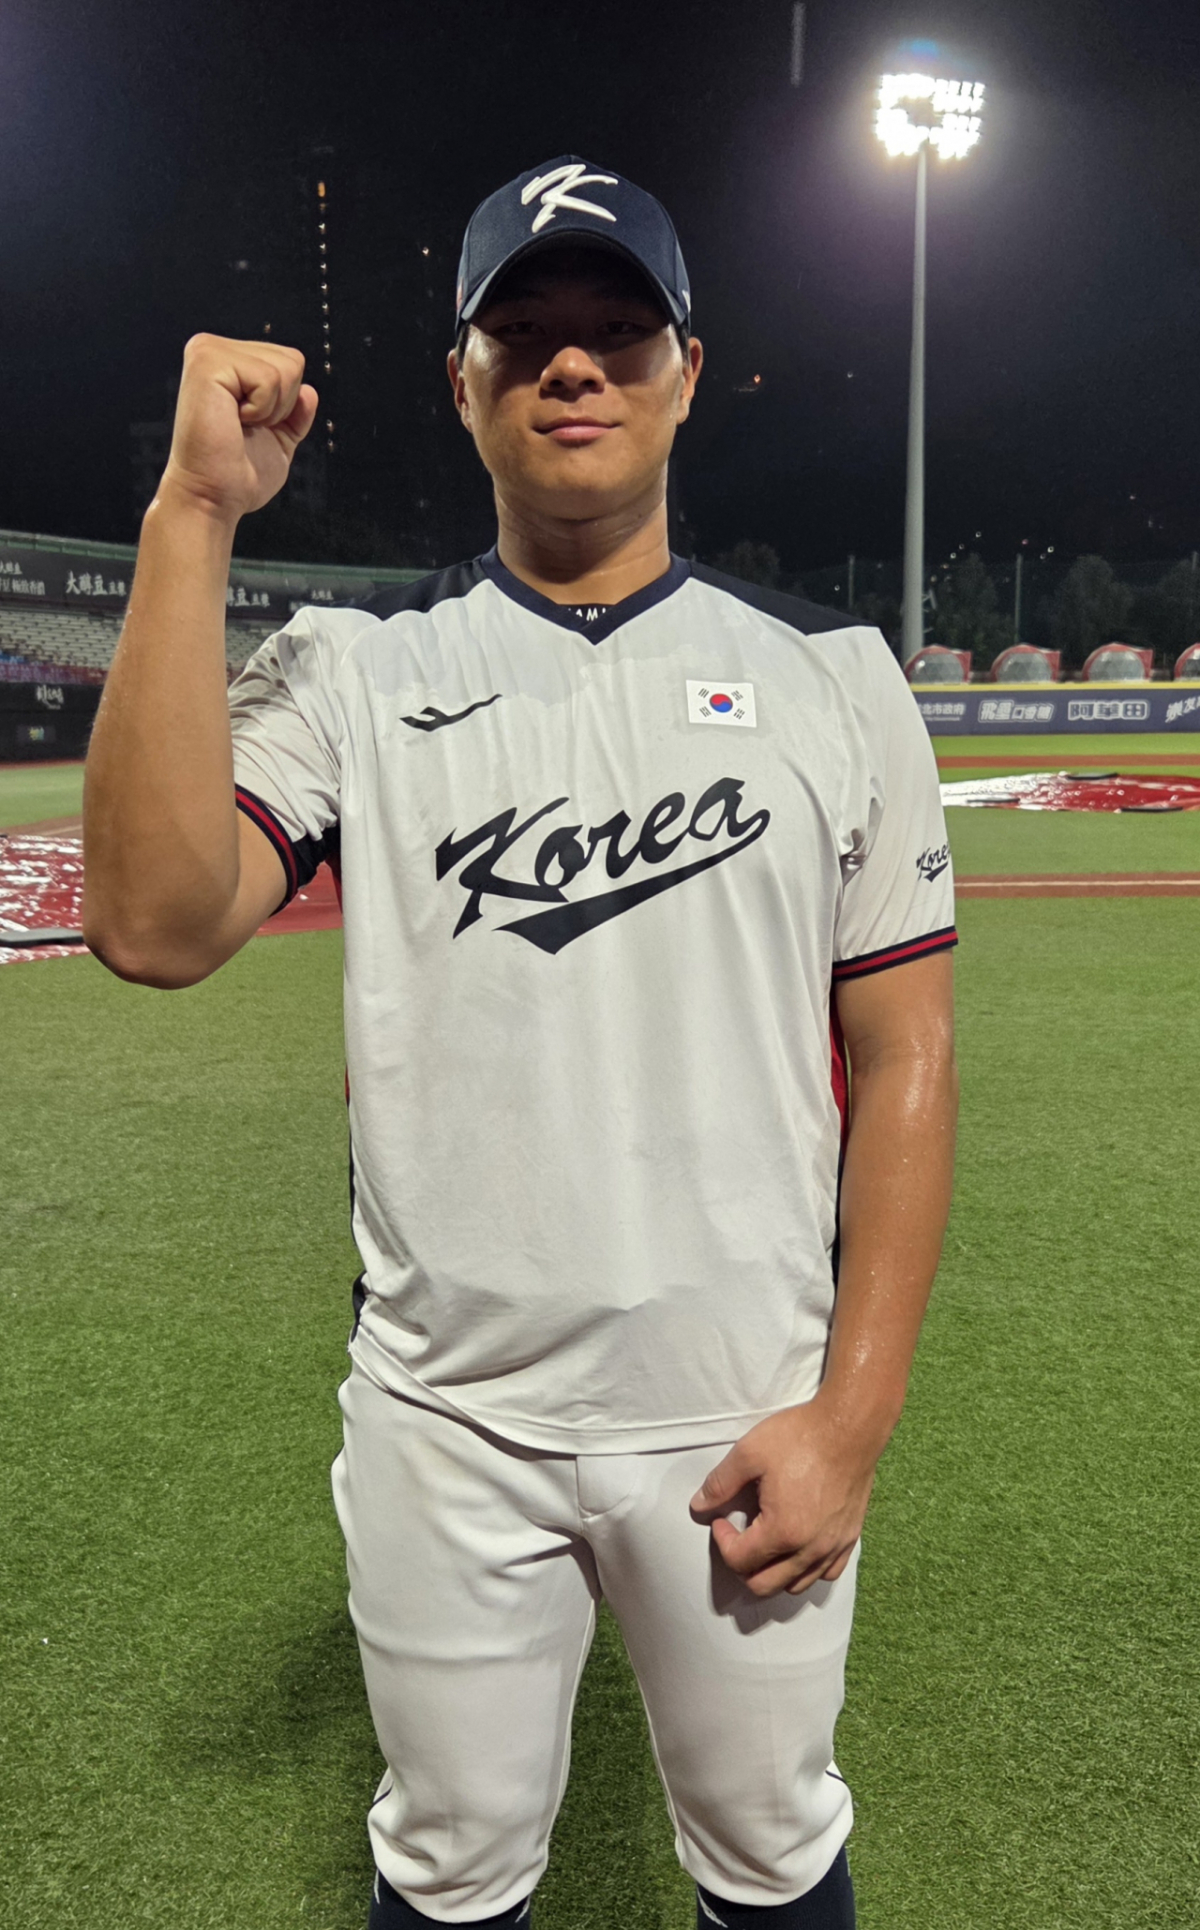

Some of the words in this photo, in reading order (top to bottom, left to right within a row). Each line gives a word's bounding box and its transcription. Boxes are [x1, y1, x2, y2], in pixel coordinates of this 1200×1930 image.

[520, 163, 619, 234] K
[918, 702, 966, 716] 北市政府
[435, 776, 771, 956] Korea
[915, 841, 951, 883] Kore
